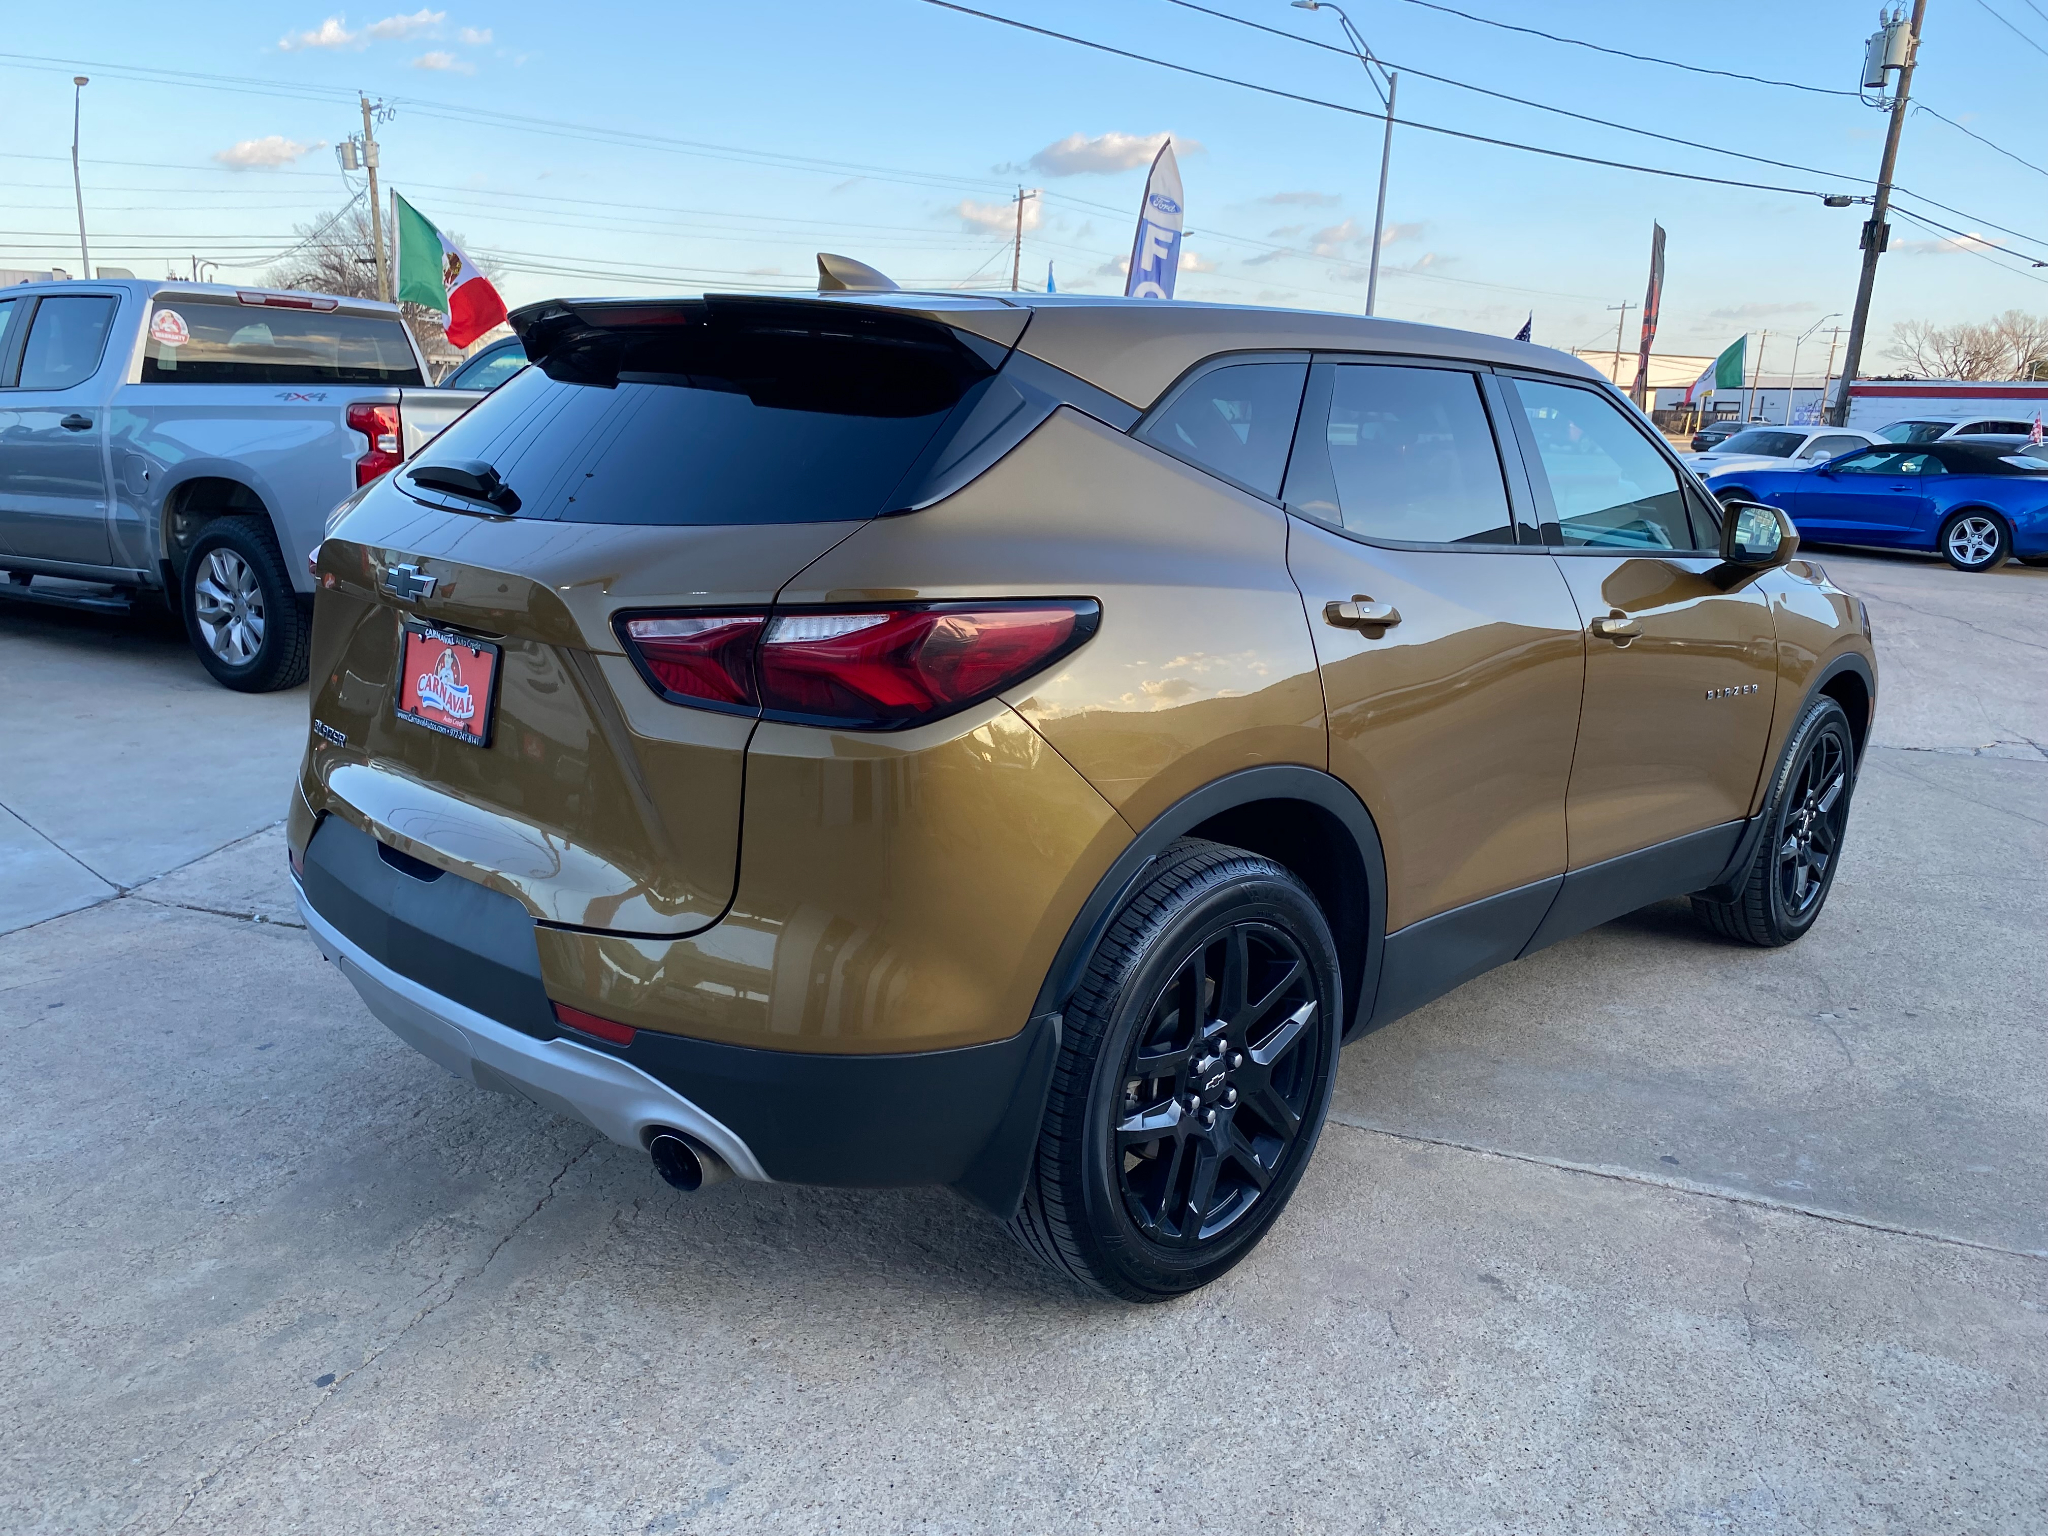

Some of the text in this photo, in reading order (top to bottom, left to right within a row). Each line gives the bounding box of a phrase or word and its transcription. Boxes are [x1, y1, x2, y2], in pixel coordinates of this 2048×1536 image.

[1152, 195, 1177, 214] Ford
[417, 673, 474, 715] CARNAVAL
[1706, 684, 1758, 701] BLAZER
